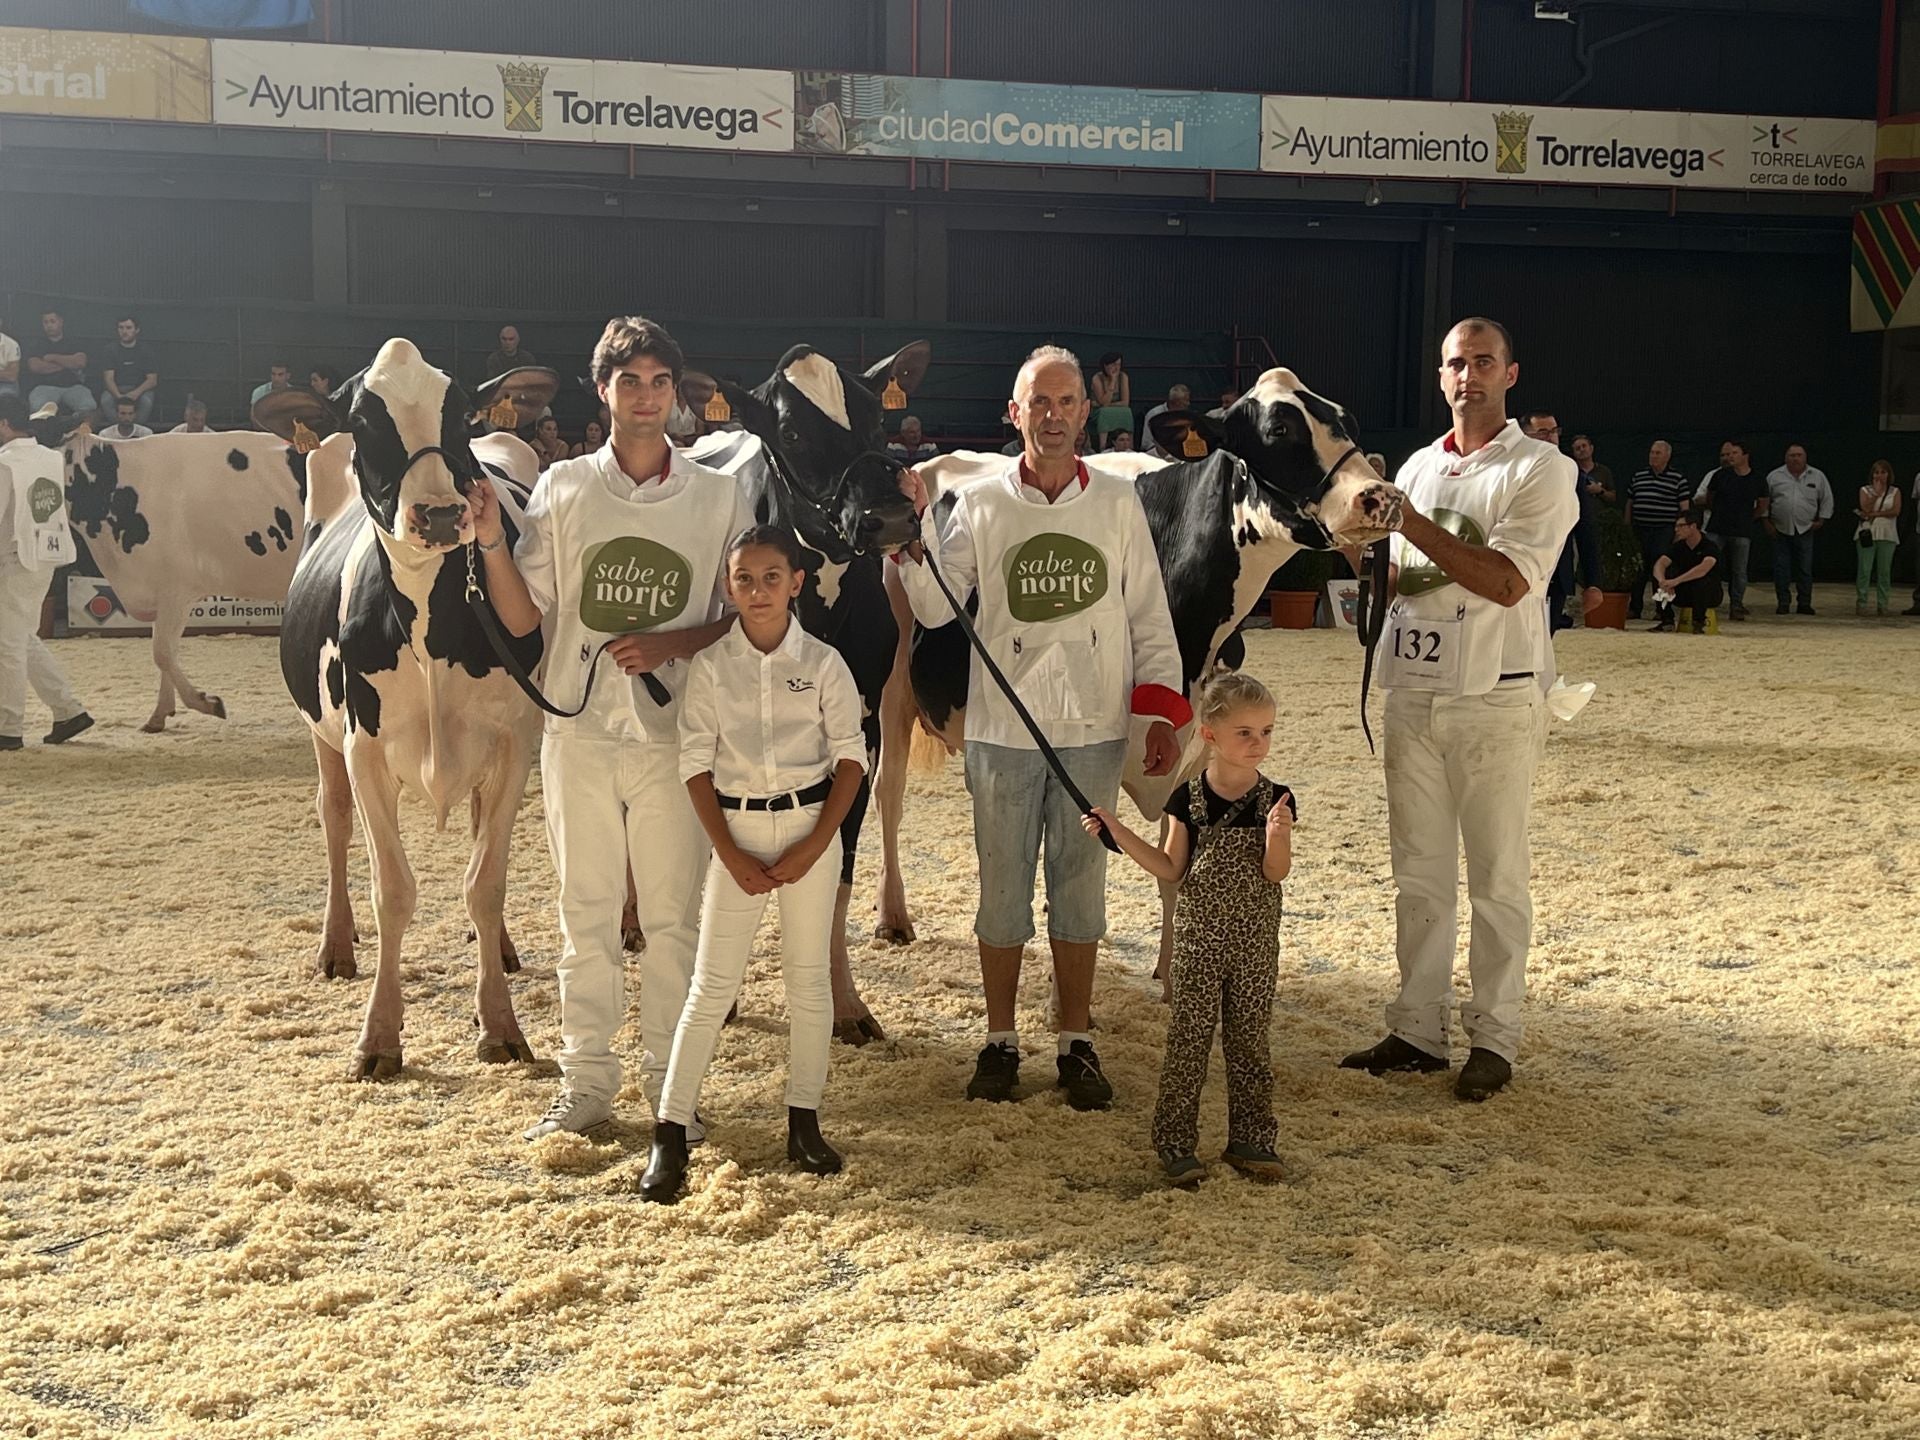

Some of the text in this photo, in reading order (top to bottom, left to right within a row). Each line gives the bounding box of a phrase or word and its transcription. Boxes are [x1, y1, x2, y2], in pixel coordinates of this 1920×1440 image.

[248, 74, 758, 141] Ayuntamiento Torrelavega
[1289, 126, 1704, 178] Ayuntamiento Torrelavega
[1750, 151, 1866, 169] TORRELAVEGA
[1750, 172, 1848, 187] cerca de todo
[47, 535, 60, 552] 84
[594, 556, 681, 587] sabe a
[1017, 550, 1097, 576] sabe a
[594, 582, 678, 617] norte
[1019, 573, 1095, 603] norte
[208, 605, 227, 617] de
[1394, 627, 1441, 663] 132
